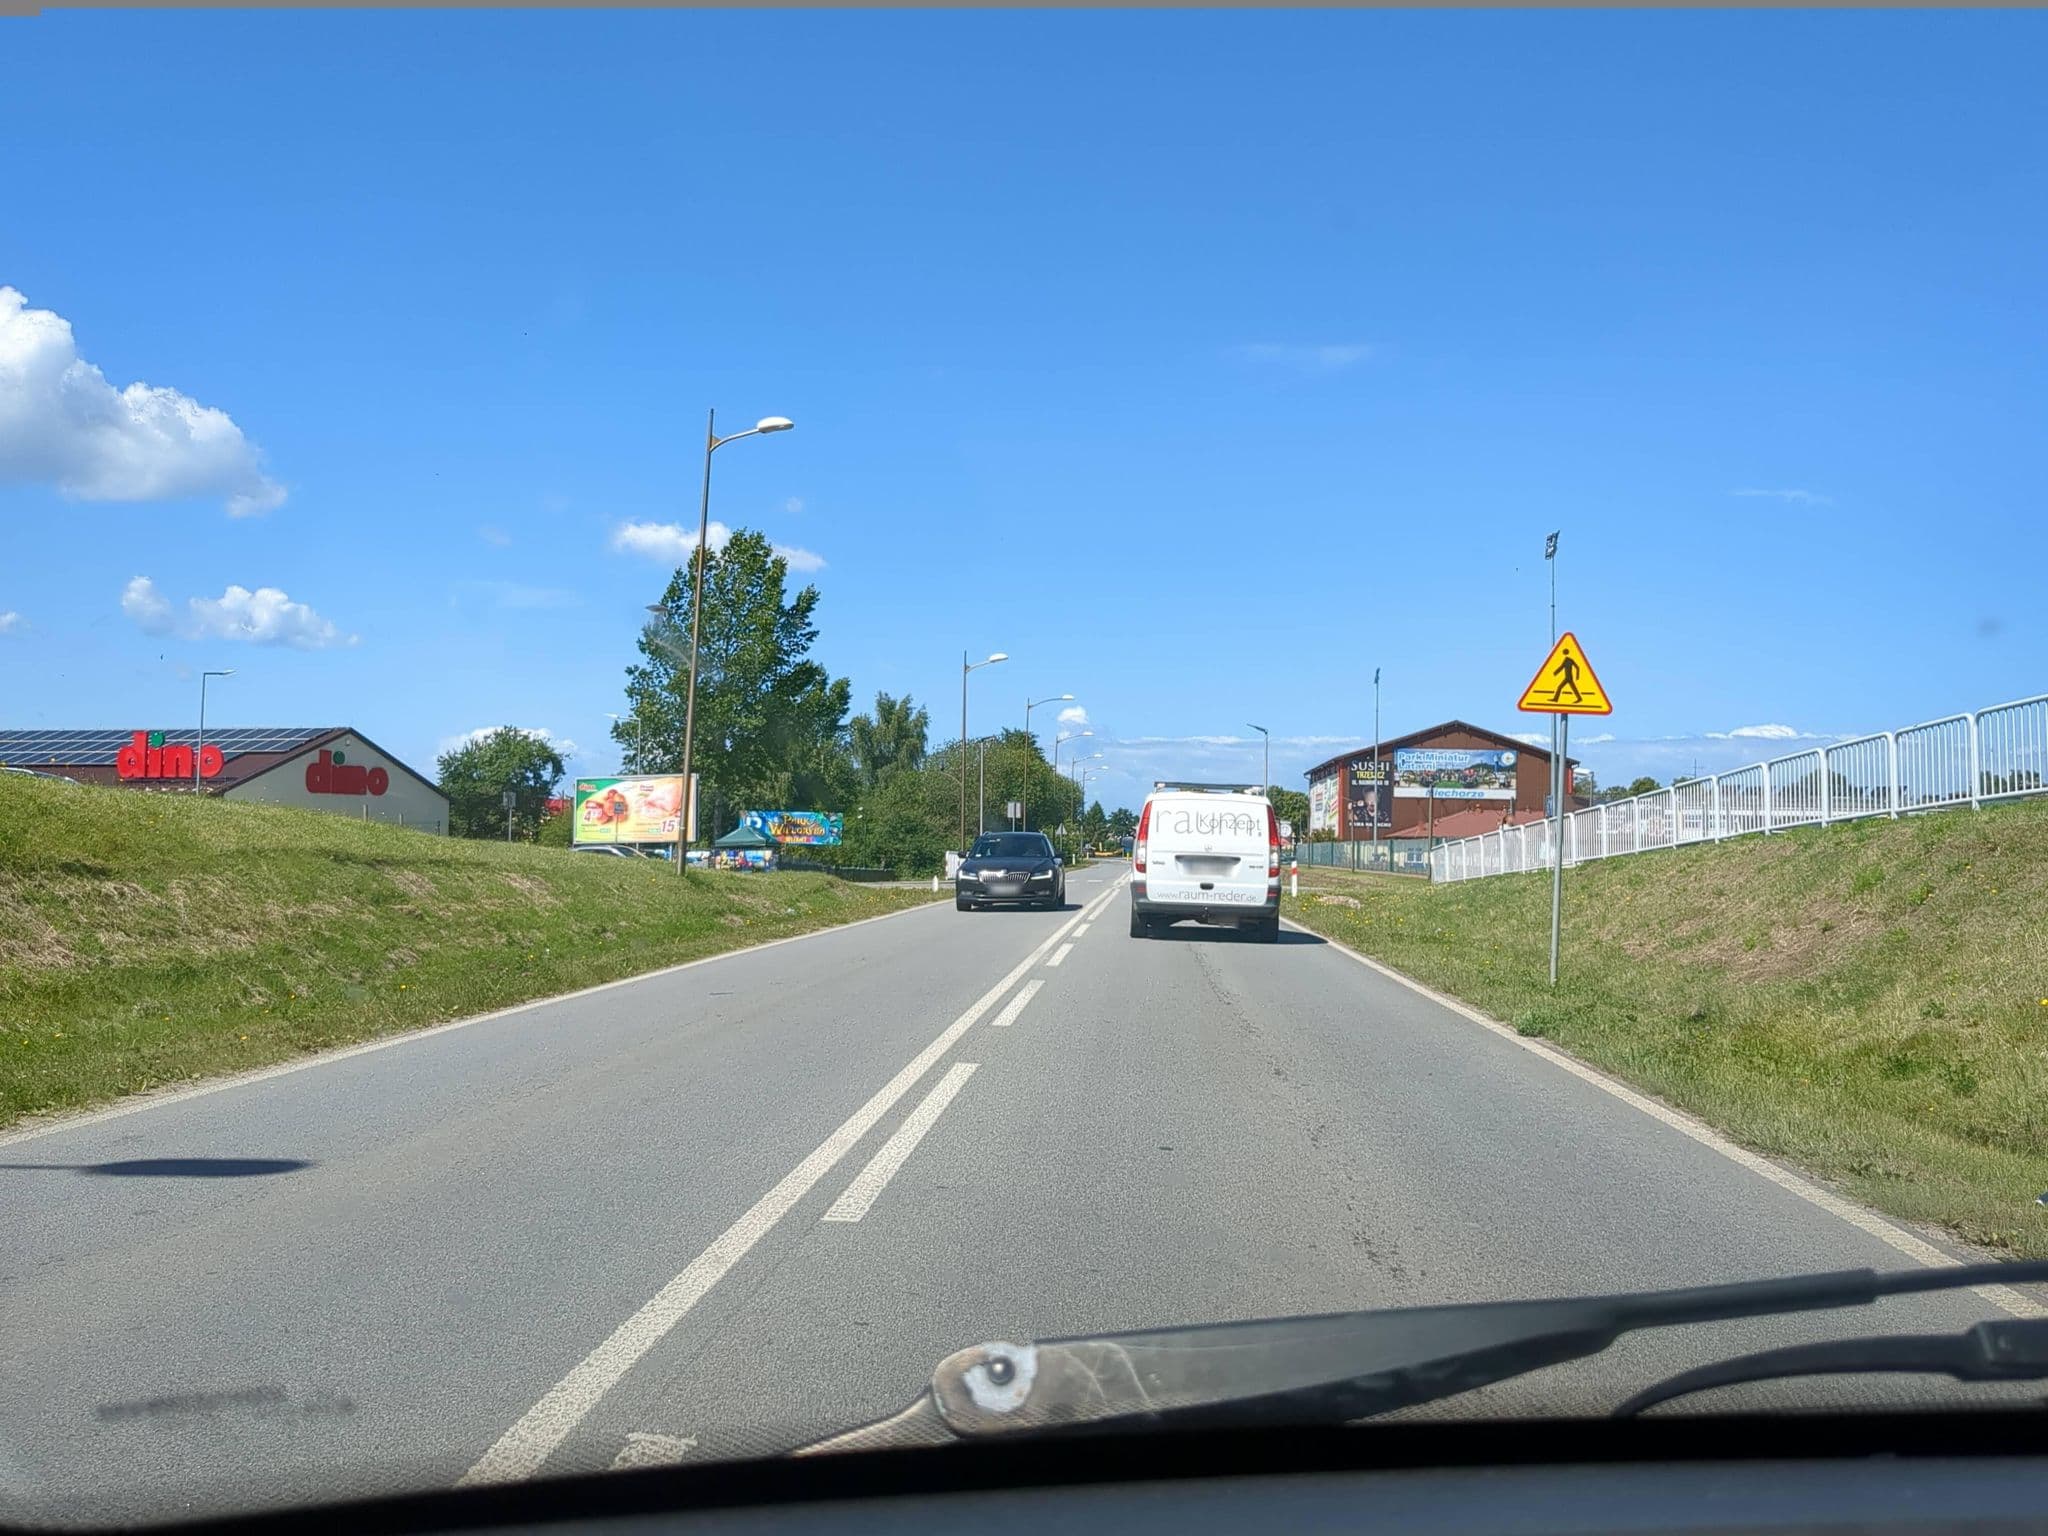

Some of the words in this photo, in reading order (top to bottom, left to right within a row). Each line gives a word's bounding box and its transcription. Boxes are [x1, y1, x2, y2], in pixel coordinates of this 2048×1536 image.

[117, 731, 224, 778] dino
[1398, 752, 1423, 763] Park
[1425, 753, 1469, 763] Miniatur
[1351, 760, 1389, 771] SUSHI
[1398, 762, 1436, 771] Latarni
[306, 750, 389, 796] dino
[662, 819, 675, 833] 15
[1157, 890, 1257, 902] www.raum-reder.de
